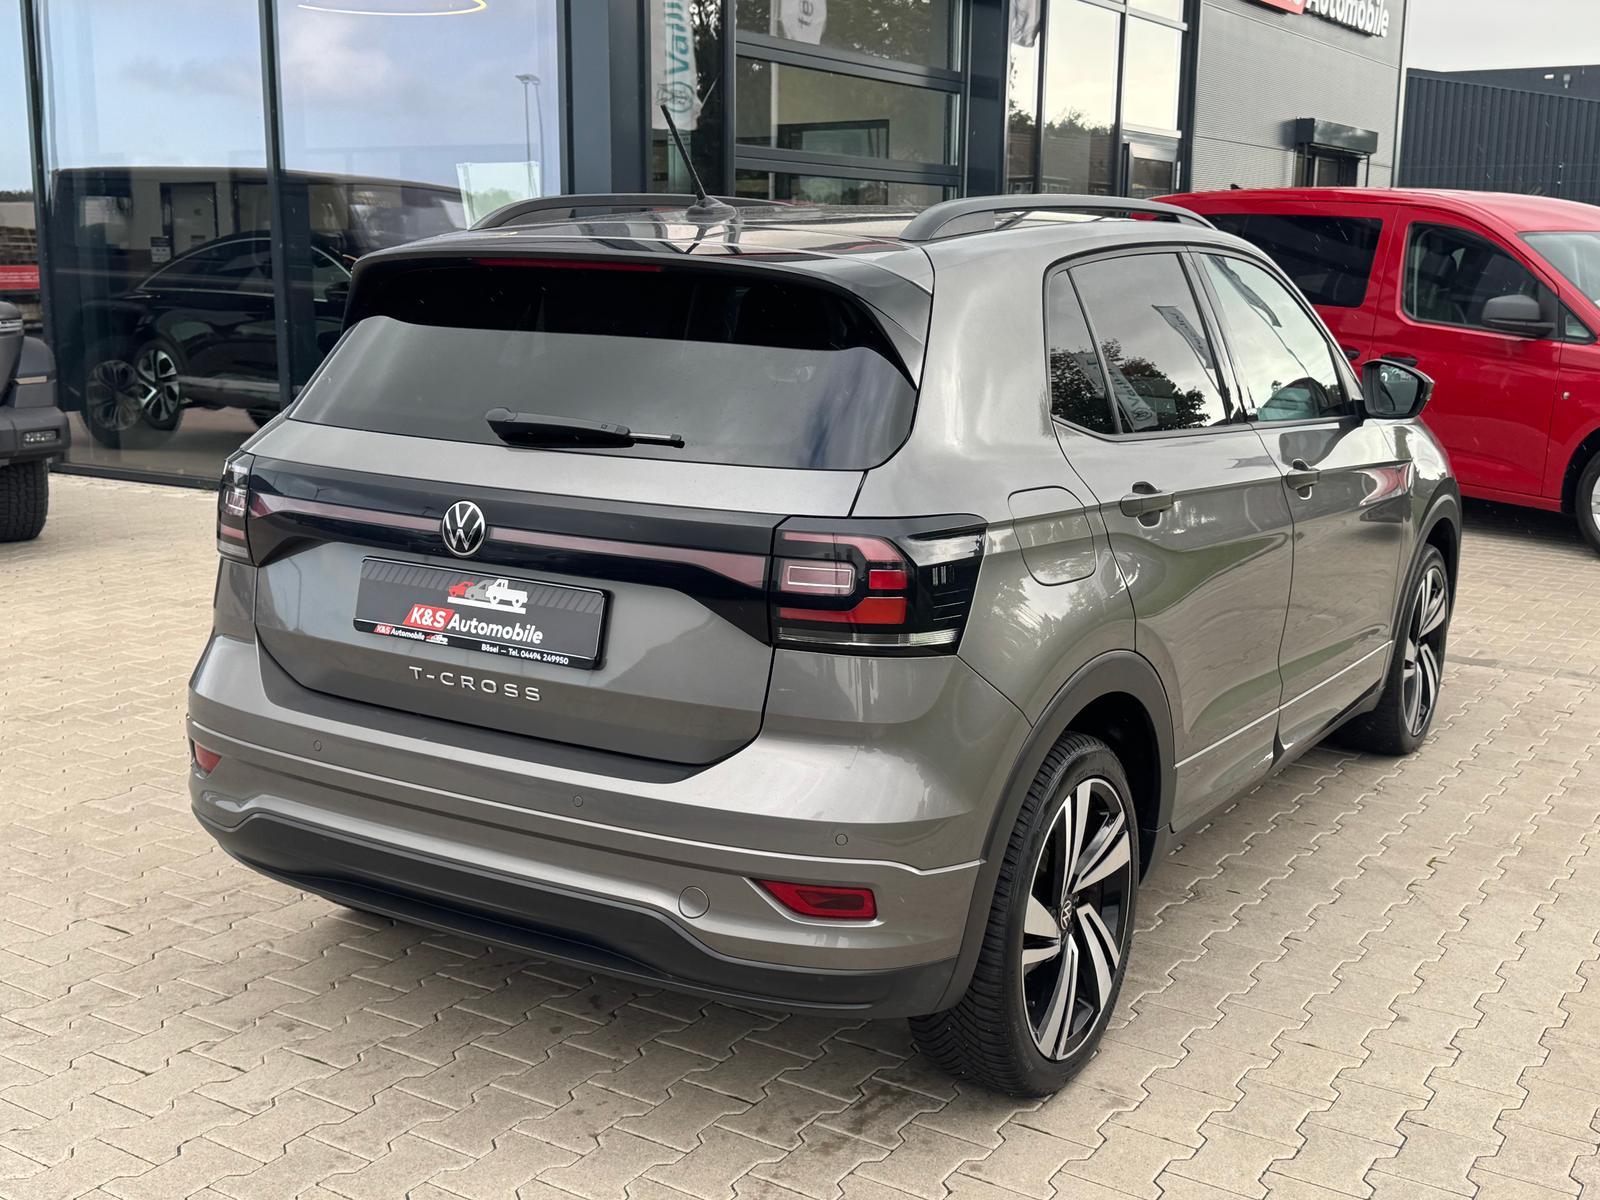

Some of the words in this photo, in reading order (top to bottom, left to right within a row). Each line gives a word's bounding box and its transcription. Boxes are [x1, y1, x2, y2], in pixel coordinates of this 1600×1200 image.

[390, 627, 426, 641] Automobile
[410, 606, 447, 629] K&S
[446, 613, 544, 645] Automobile
[481, 643, 499, 653] Bösel
[520, 650, 541, 661] 04494
[542, 653, 569, 665] 249950
[408, 665, 541, 702] T-CROSS
